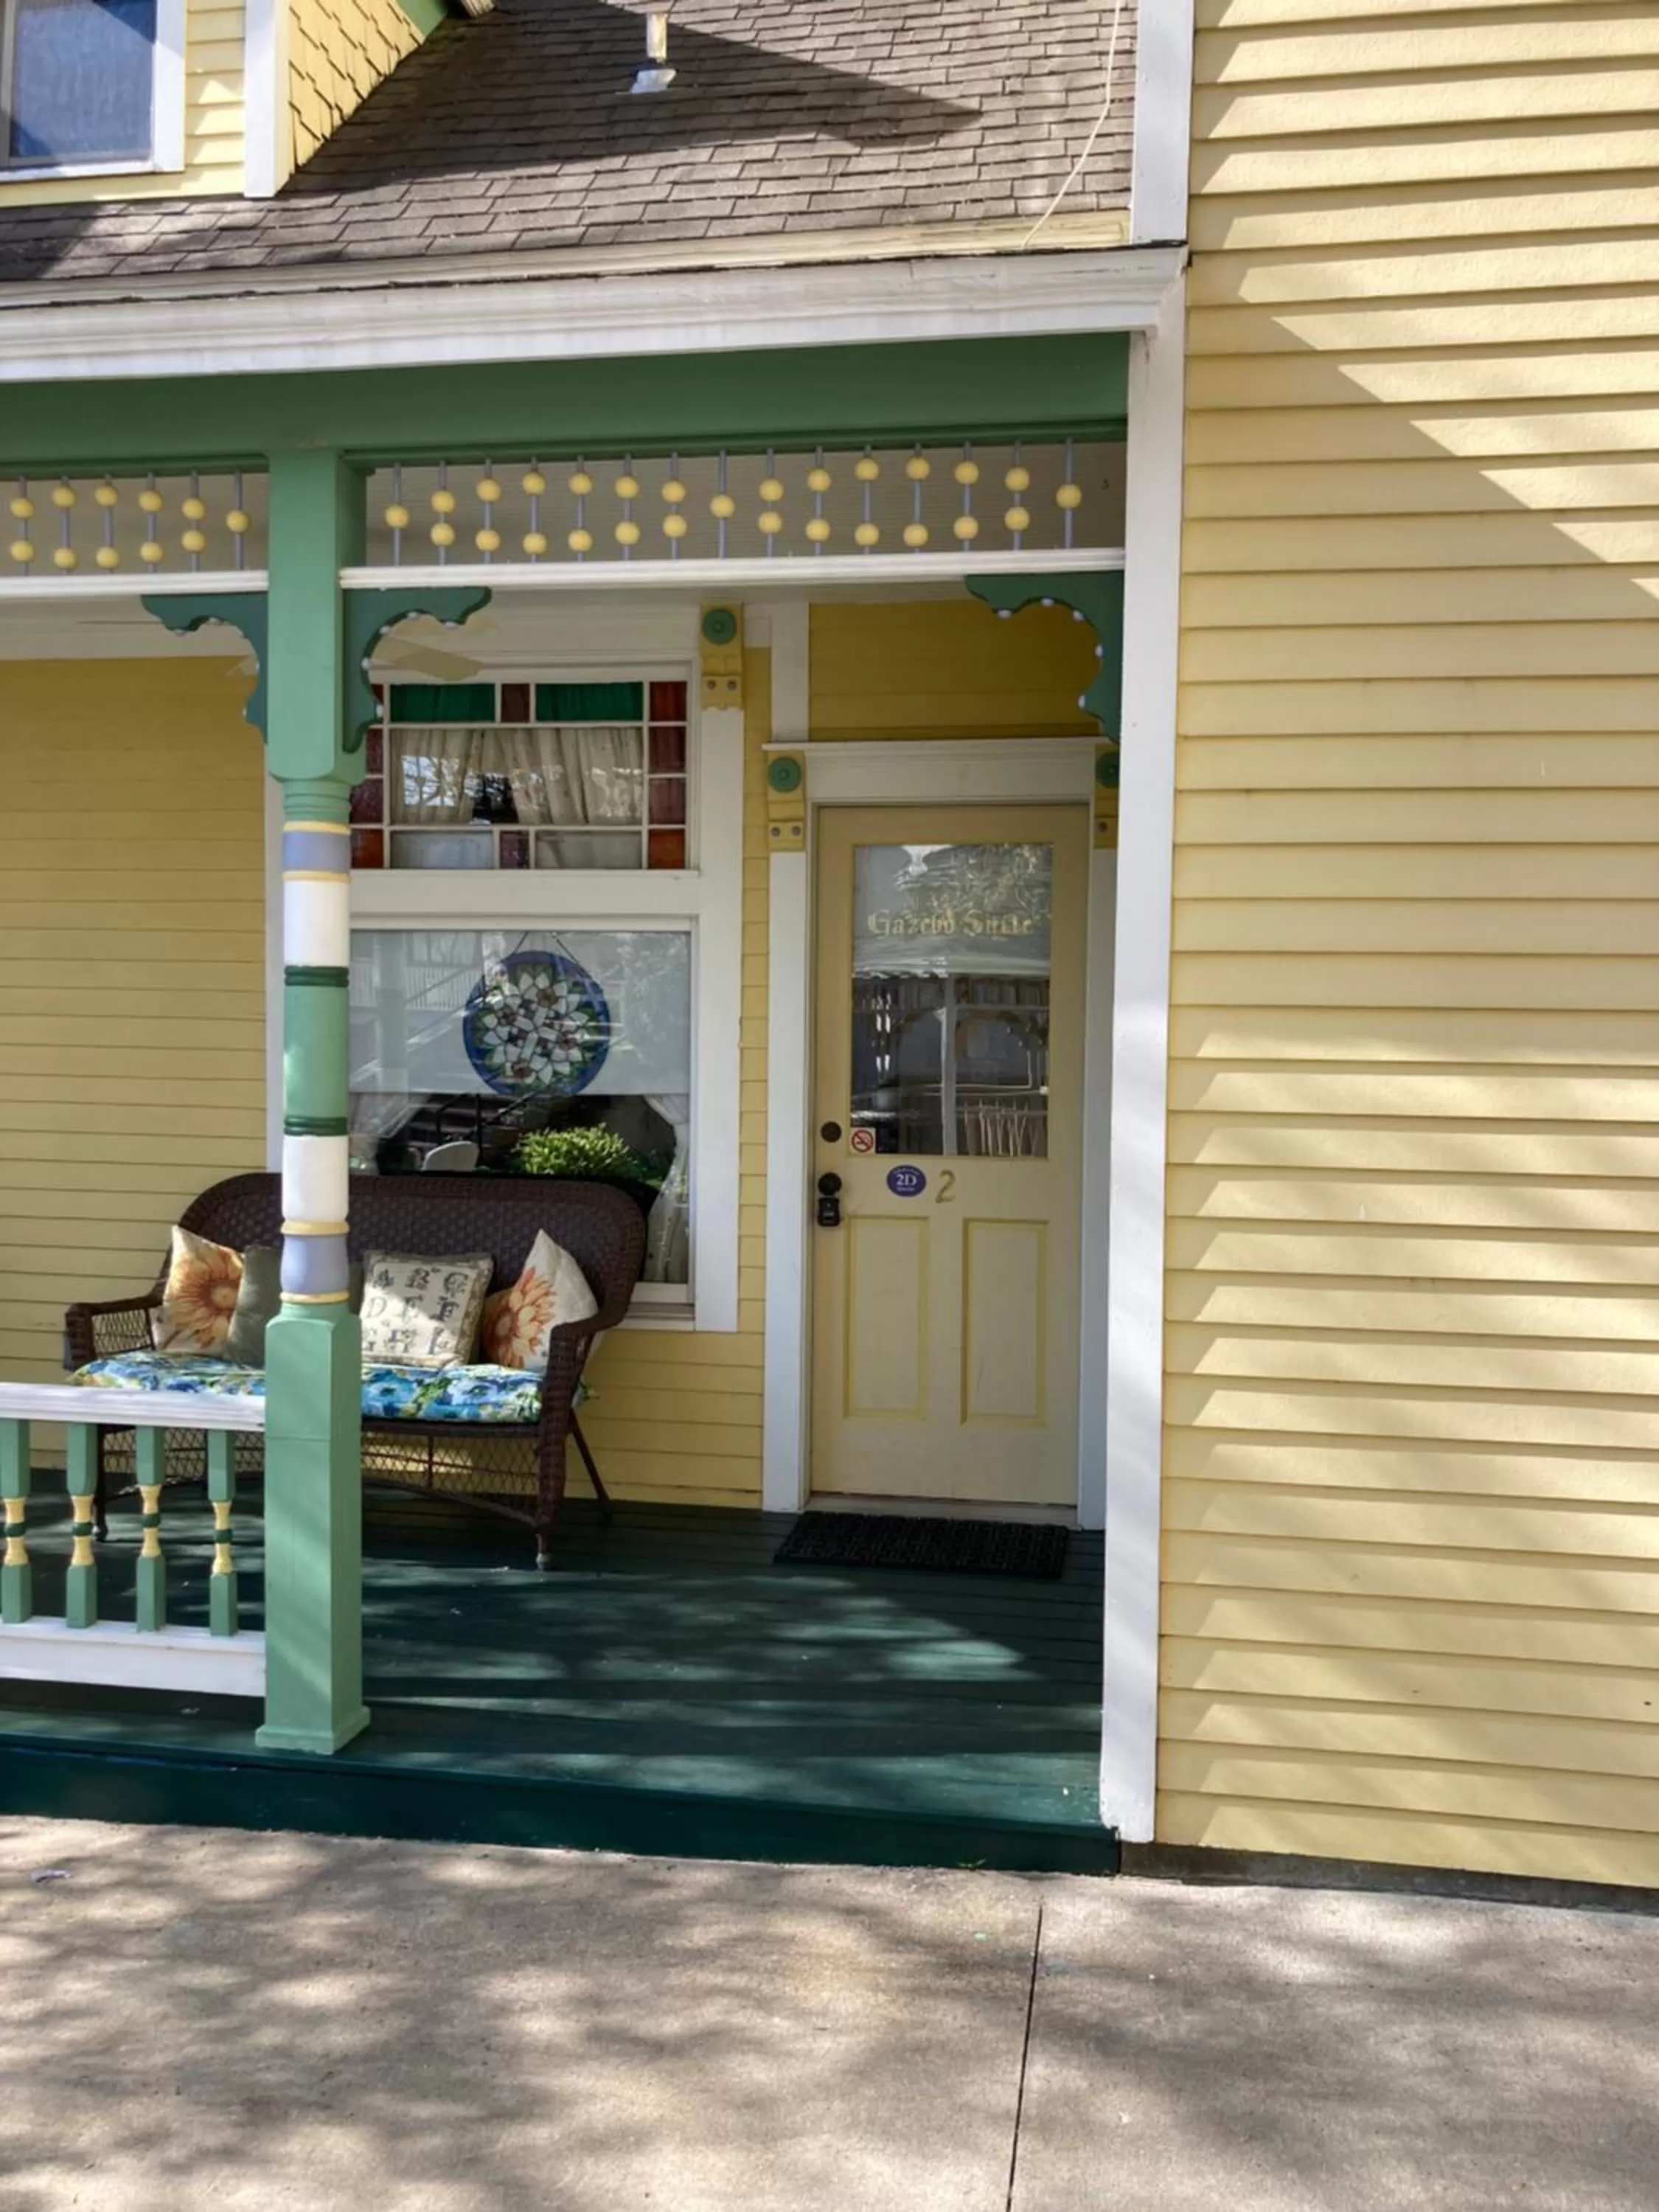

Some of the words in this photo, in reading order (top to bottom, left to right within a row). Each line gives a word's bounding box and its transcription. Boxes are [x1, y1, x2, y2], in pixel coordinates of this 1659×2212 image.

[962, 909, 1034, 937] Suite
[896, 1173, 918, 1186] 2D
[935, 1169, 956, 1204] 2
[366, 1296, 389, 1319] D
